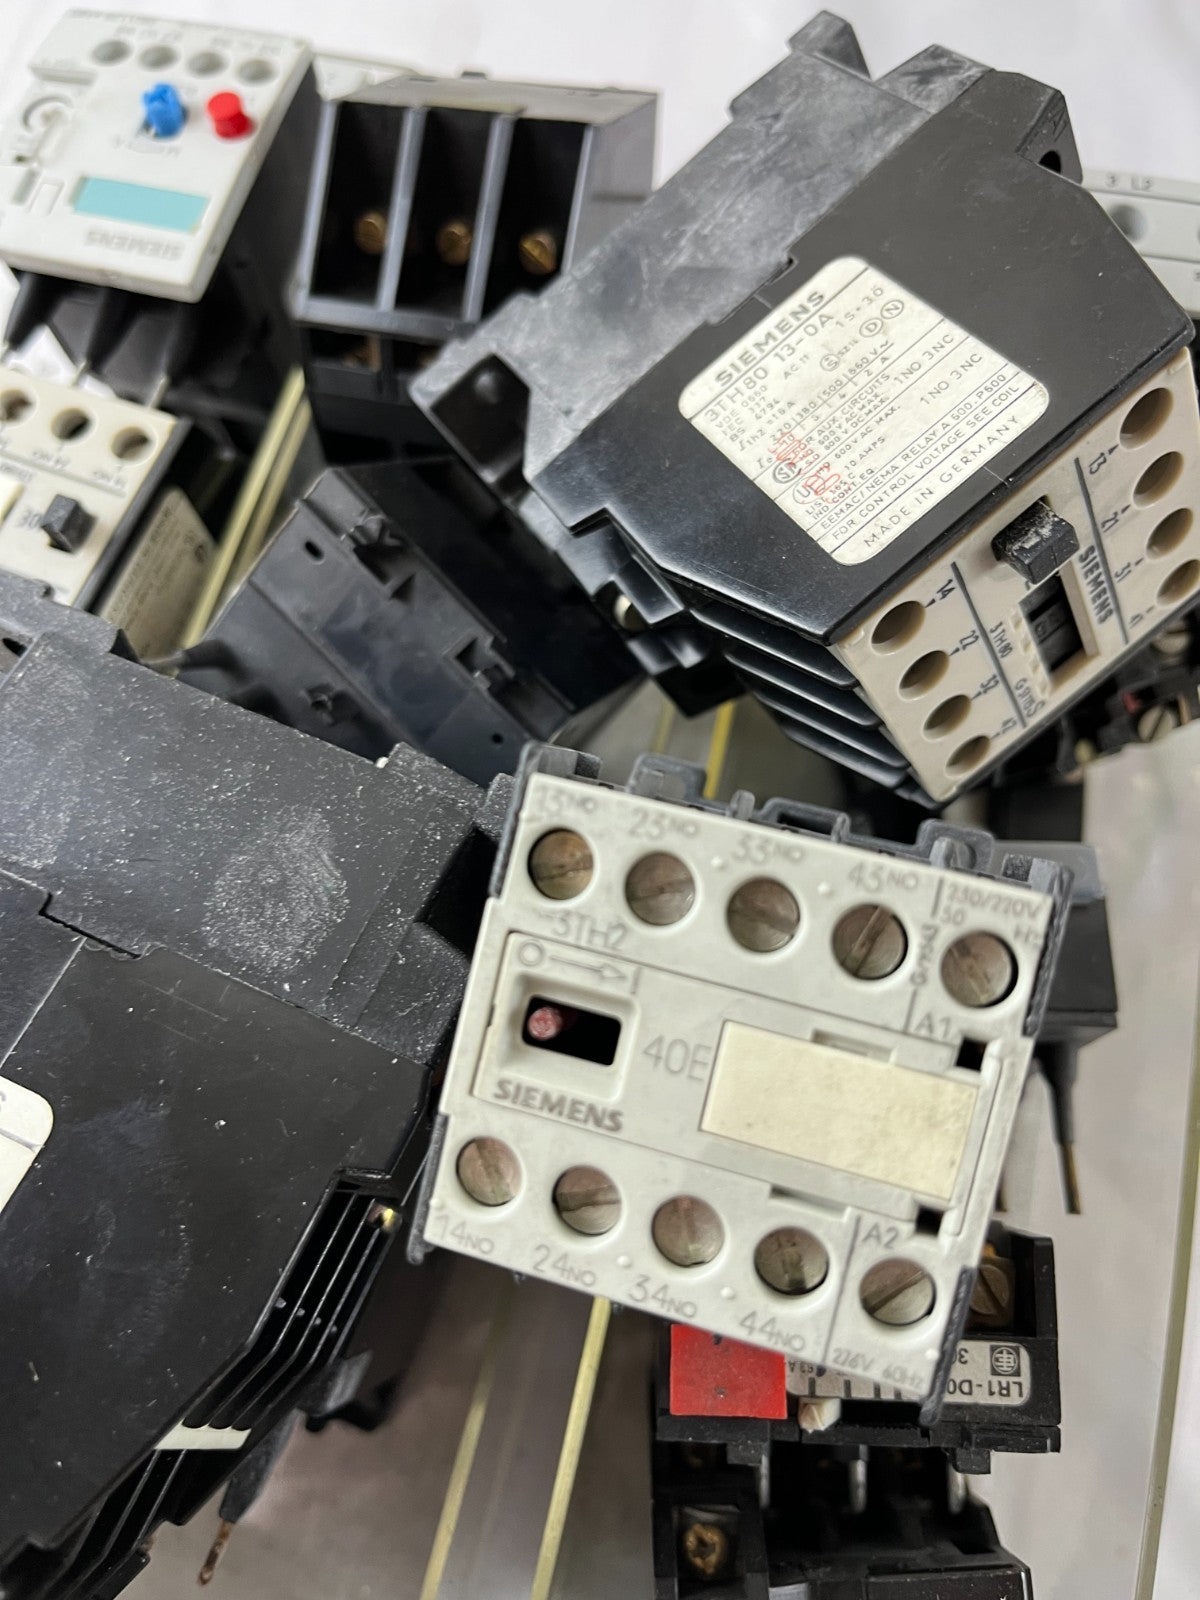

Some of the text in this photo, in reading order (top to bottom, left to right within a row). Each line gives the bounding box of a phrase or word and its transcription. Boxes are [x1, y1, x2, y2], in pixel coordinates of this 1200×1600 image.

[714, 288, 826, 387] SIEMENS
[901, 429, 939, 462] RELAY
[831, 382, 1019, 540] FOR CONTROL VOLTAGE SEE COIL
[1088, 453, 1107, 475] 13
[863, 414, 1020, 547] MADE IN GERMANY
[1101, 512, 1119, 533] 21
[1078, 545, 1114, 625] SIEMENS
[1114, 562, 1131, 583] 31
[936, 579, 956, 601] 14
[959, 629, 980, 651] 22
[979, 673, 1000, 695] 32
[915, 1013, 951, 1038] A1
[643, 1034, 713, 1083] 40E
[493, 1078, 625, 1134] SIEMENS
[861, 1222, 900, 1250] A2
[434, 1213, 807, 1353] 14NO 24NO 34NO 44NO
[946, 1378, 1024, 1398] LR1-D0
